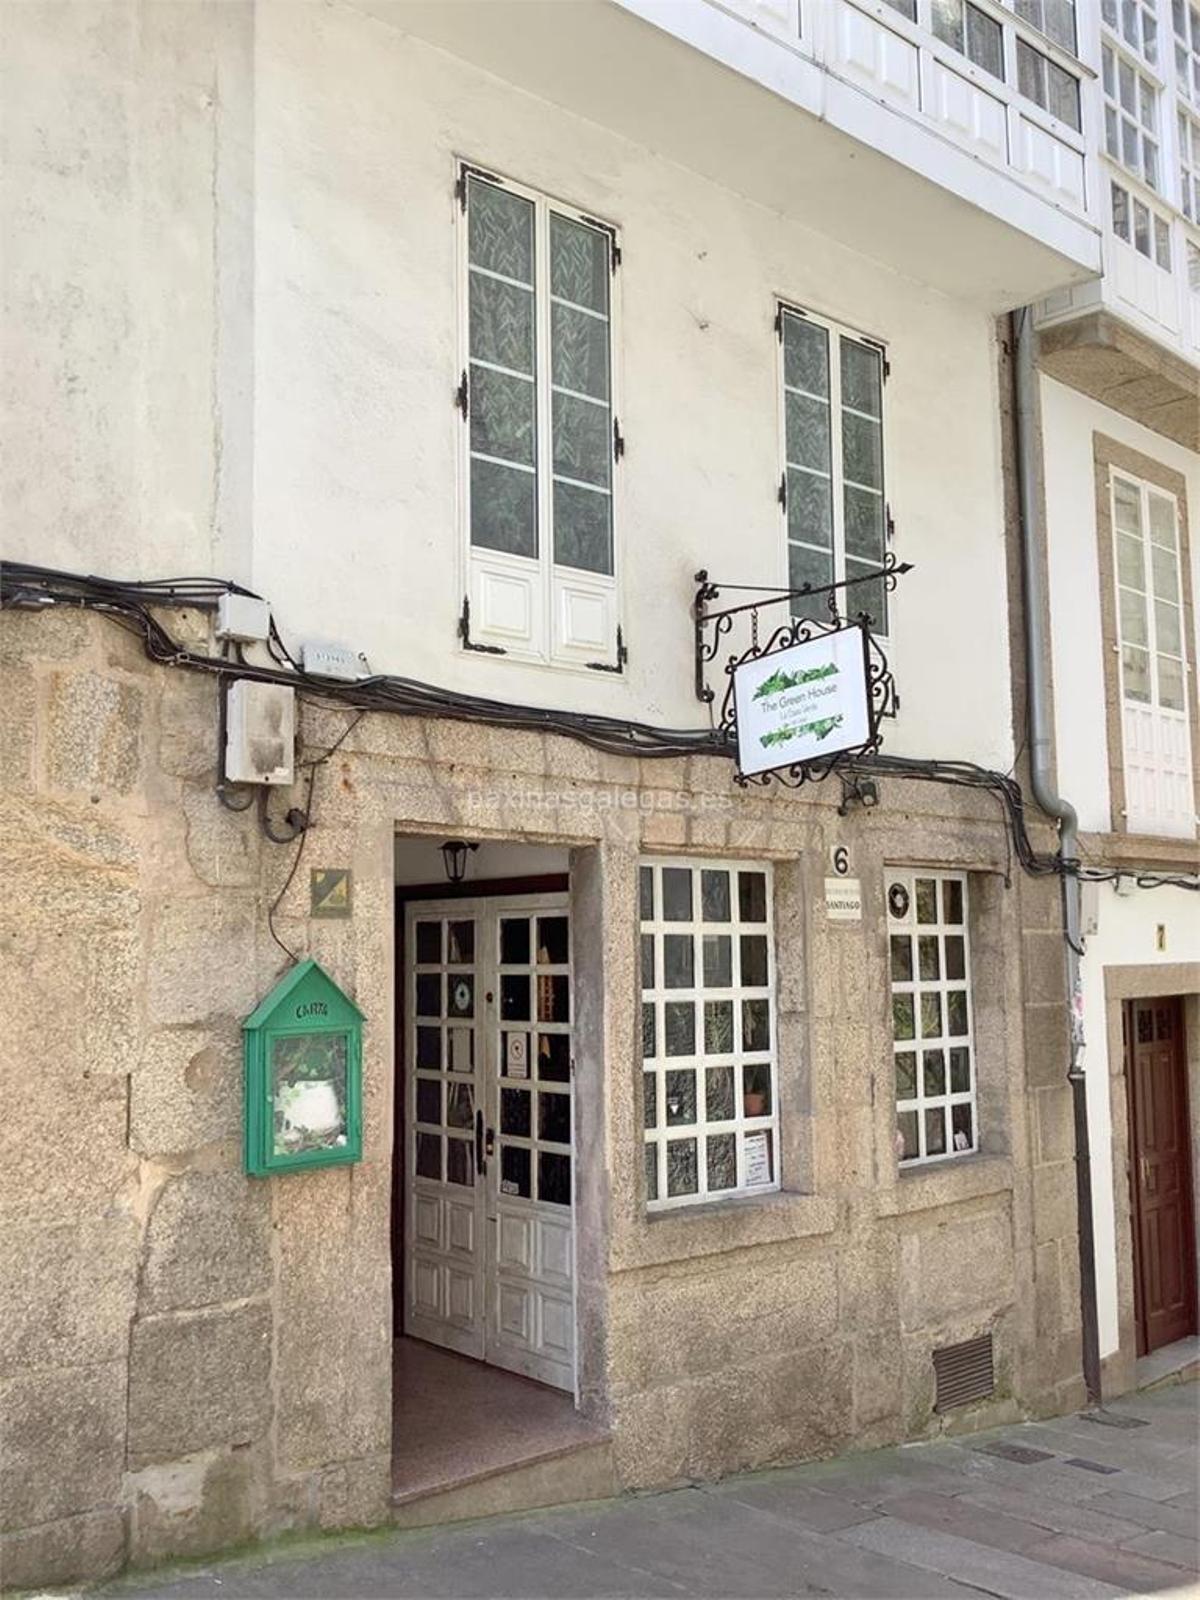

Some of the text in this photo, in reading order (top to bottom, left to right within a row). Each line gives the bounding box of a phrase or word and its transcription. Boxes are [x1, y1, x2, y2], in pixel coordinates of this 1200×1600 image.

[761, 684, 838, 713] The Green House
[834, 847, 848, 874] 6
[825, 901, 861, 910] SANTIAGO
